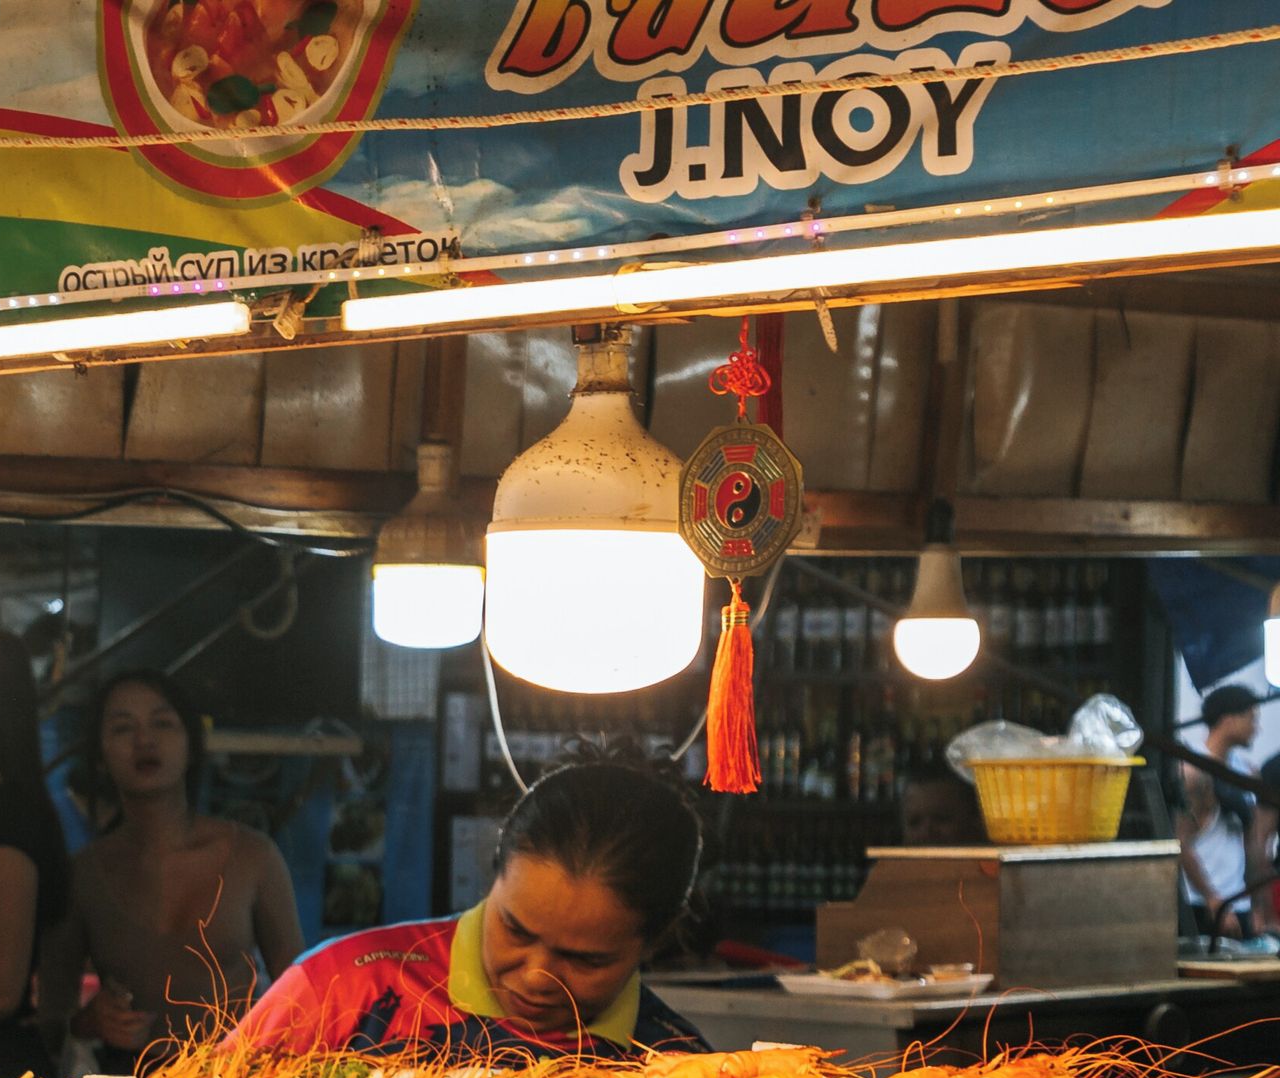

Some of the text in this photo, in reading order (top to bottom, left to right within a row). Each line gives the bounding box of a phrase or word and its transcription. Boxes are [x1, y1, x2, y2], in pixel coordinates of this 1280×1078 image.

[633, 60, 998, 186] J.NOY
[180, 256, 235, 283] суп
[248, 253, 288, 275] из
[302, 236, 458, 272] крееток
